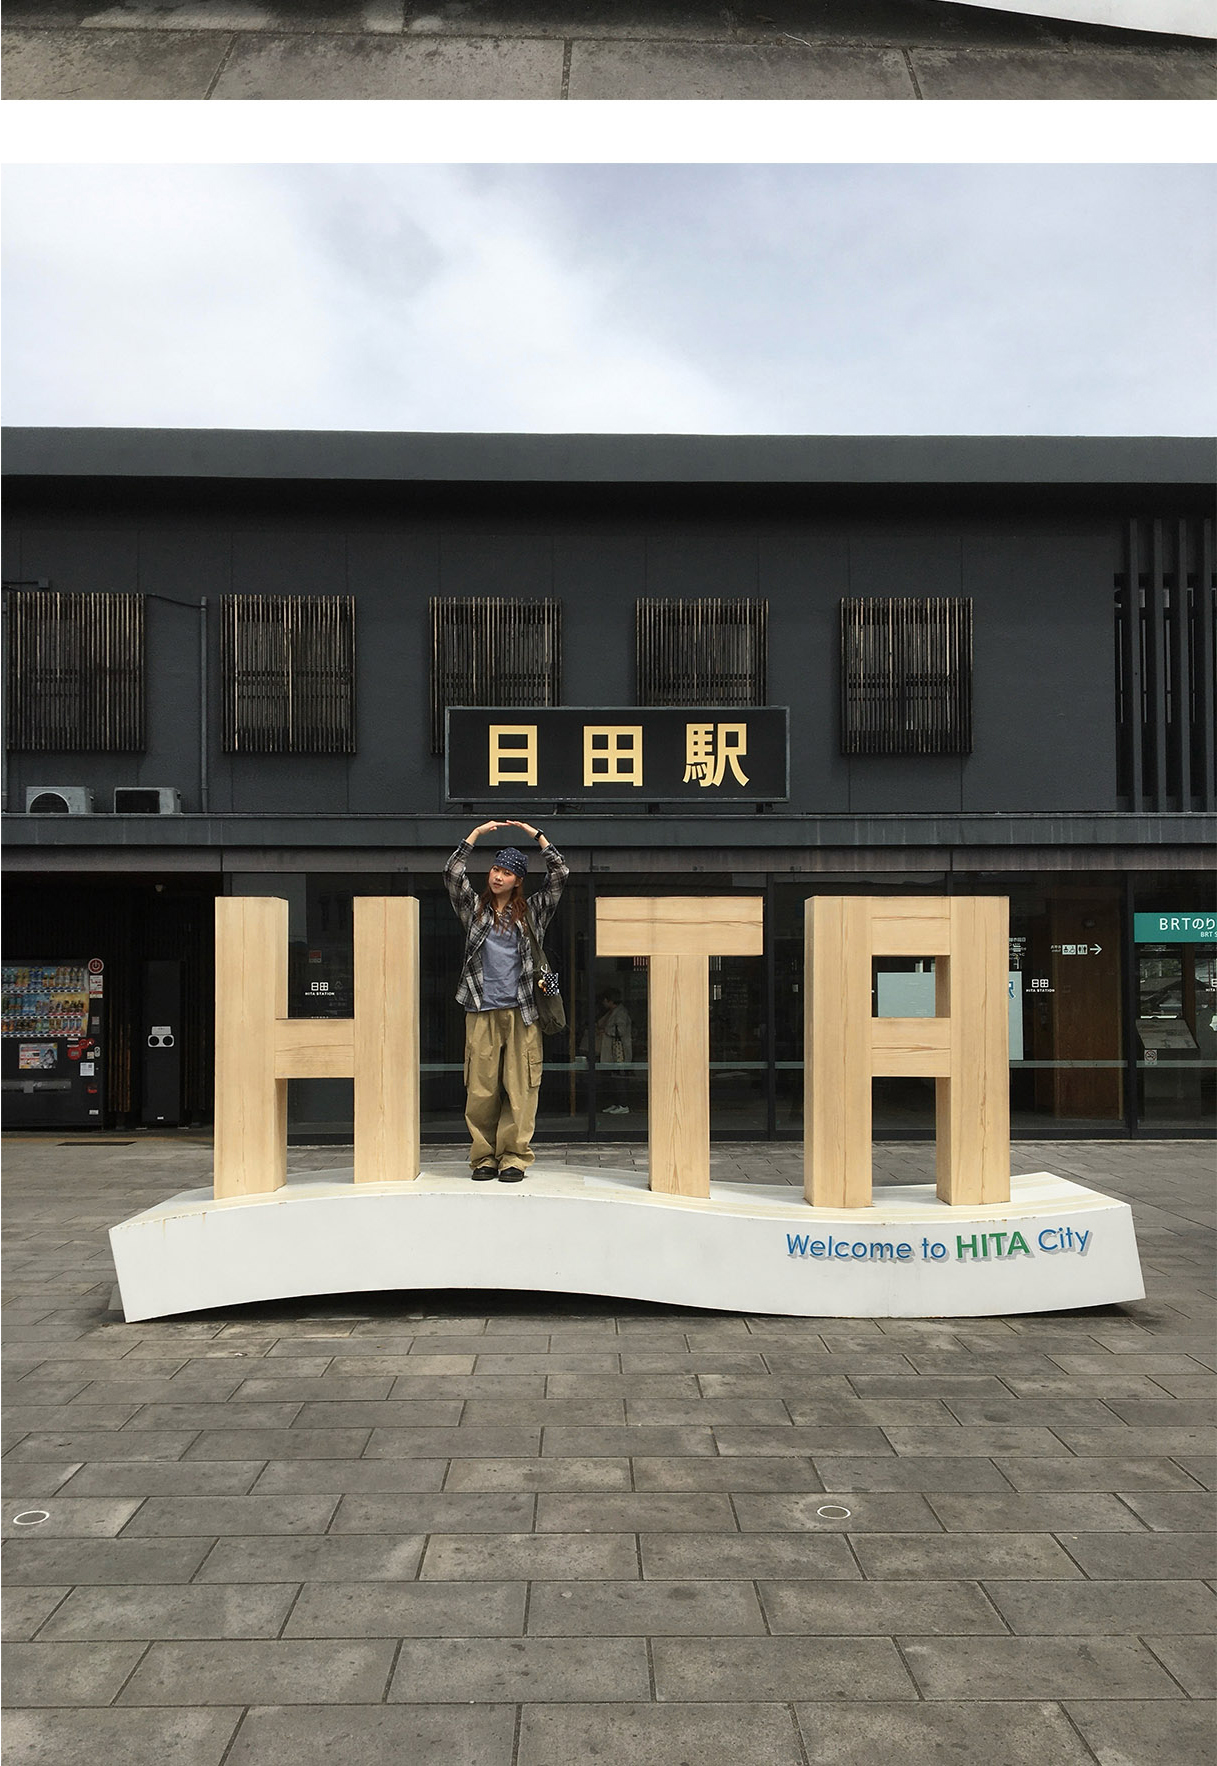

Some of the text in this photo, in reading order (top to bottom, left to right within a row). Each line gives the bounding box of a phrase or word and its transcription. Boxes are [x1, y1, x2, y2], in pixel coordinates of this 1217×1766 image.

[488, 722, 750, 788] 日田駅
[786, 1226, 1090, 1261] Welcome to HITA City
